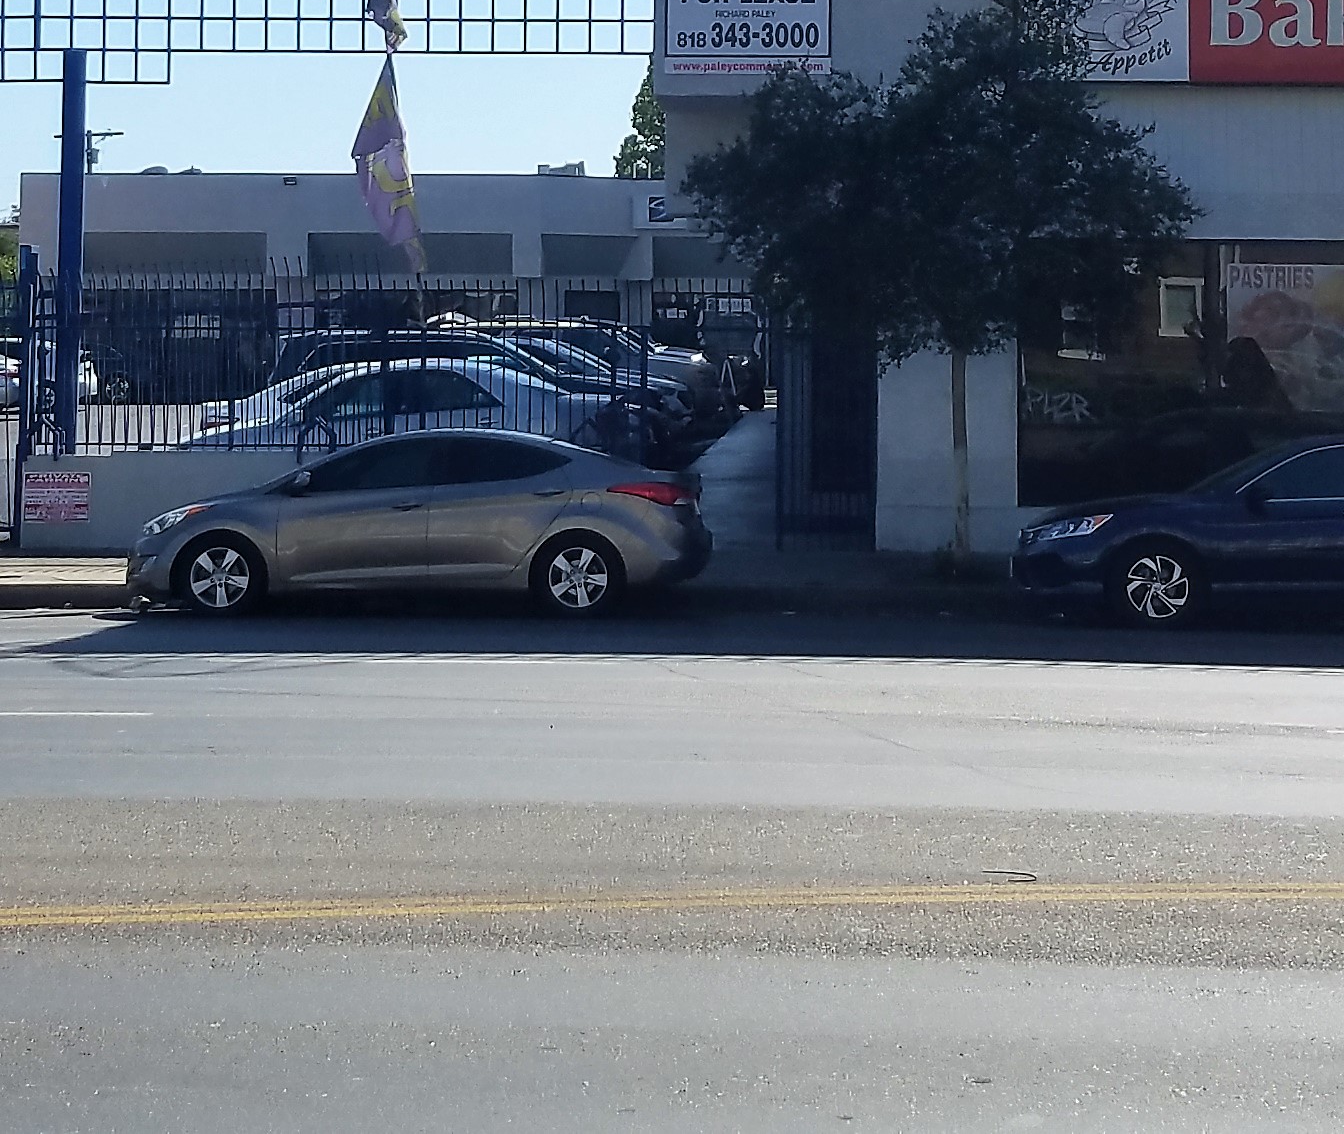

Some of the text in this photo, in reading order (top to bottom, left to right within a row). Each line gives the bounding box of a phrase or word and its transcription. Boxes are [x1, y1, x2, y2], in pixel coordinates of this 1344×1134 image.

[715, 10, 776, 18] RICHARD PALEY
[677, 22, 820, 48] 818 343-3000
[1085, 38, 1173, 76] Appetit
[1229, 266, 1315, 289] PASTRIES
